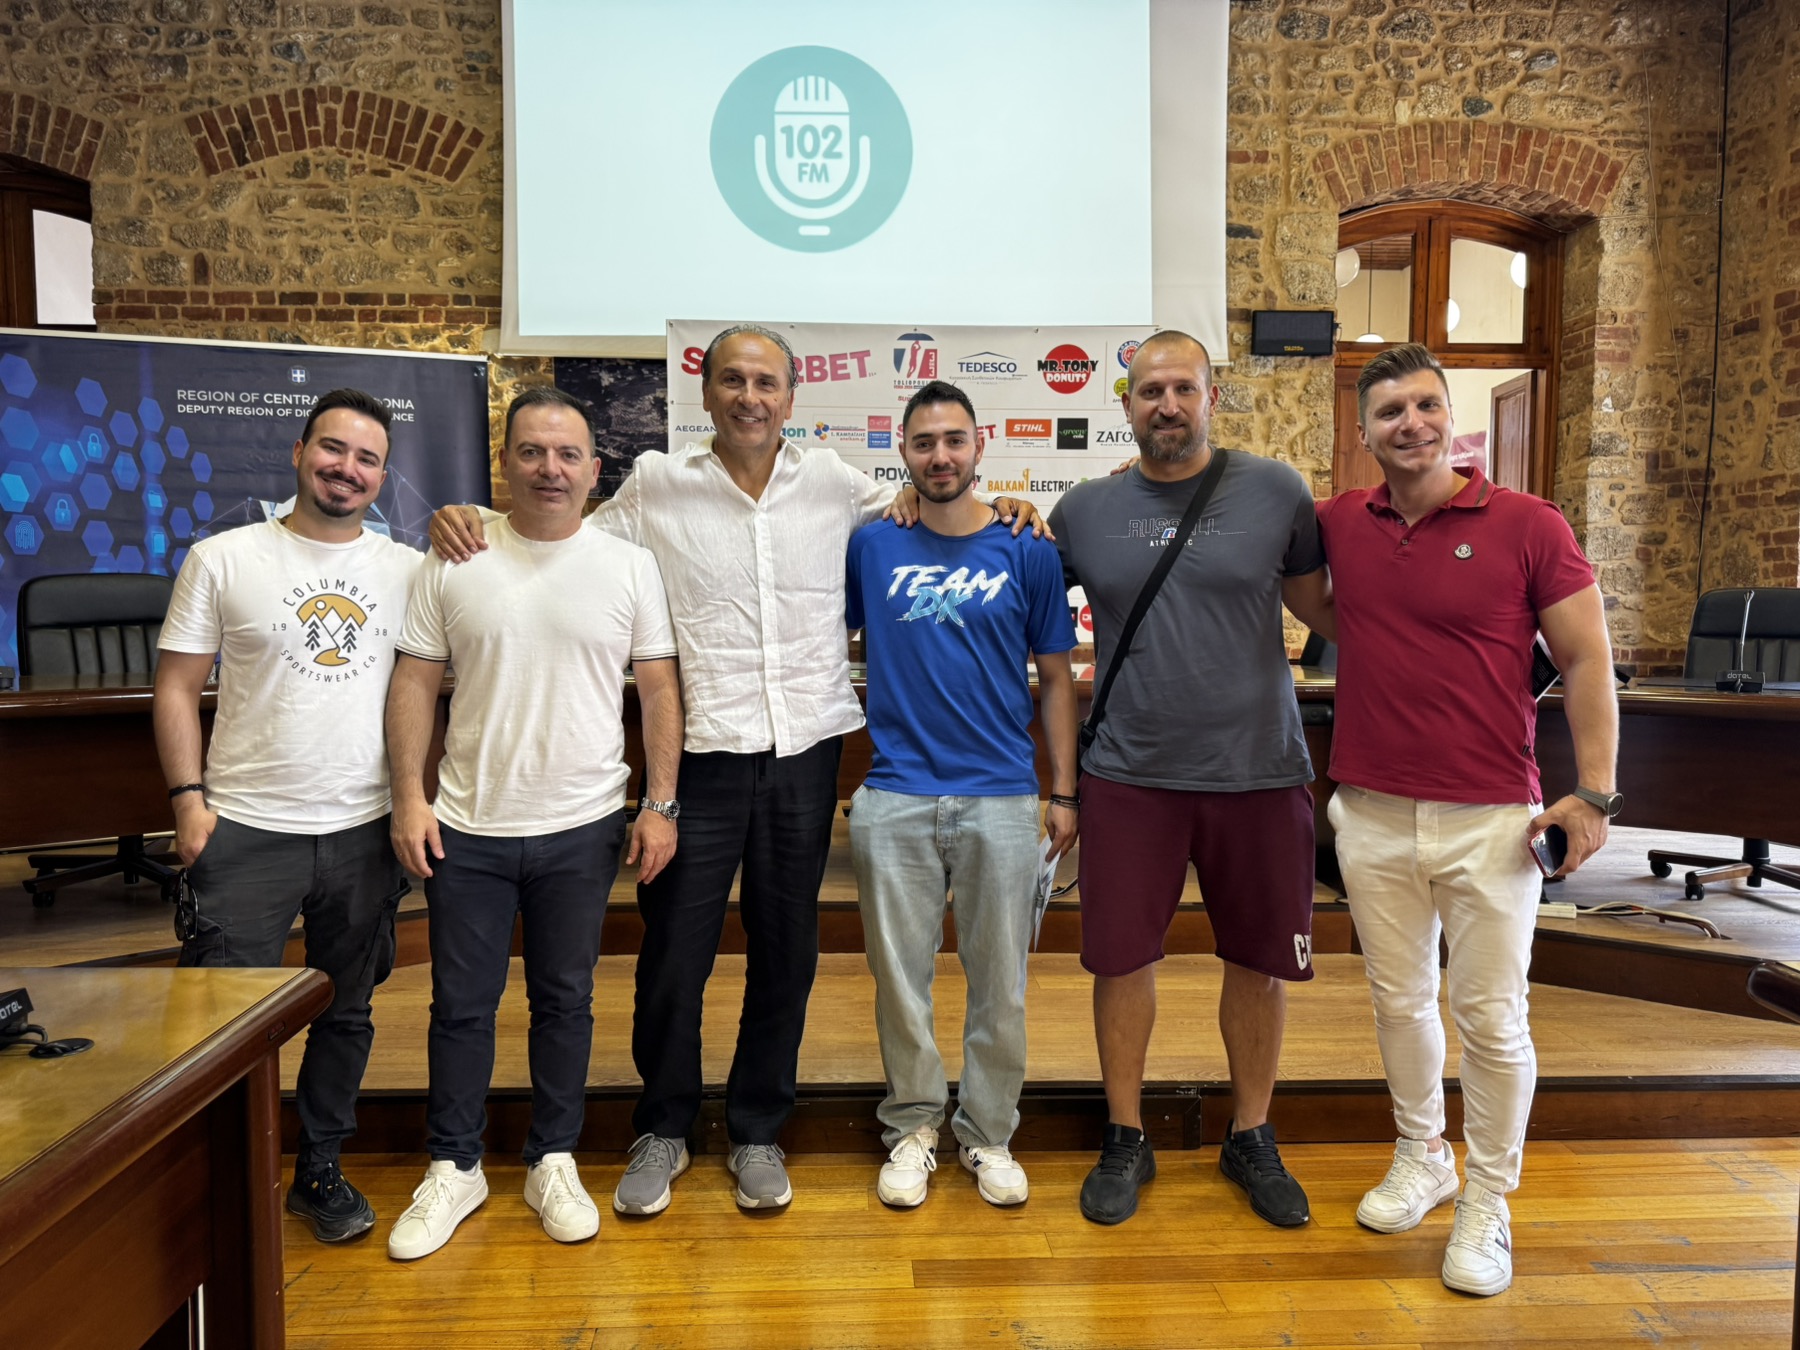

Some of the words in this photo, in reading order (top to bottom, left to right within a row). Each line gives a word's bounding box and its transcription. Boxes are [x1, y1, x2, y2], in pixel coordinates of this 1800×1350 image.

[780, 124, 843, 160] 102
[798, 163, 830, 183] FM
[958, 362, 1017, 373] TEDESCO
[1037, 360, 1099, 372] MR.TONY
[1046, 373, 1087, 383] DONUTS
[177, 390, 235, 402] REGION
[240, 393, 260, 403] OF
[263, 393, 319, 405] CENTRA
[177, 404, 224, 414] DEPUTY
[227, 406, 272, 416] REGION
[277, 408, 293, 417] OF
[1013, 424, 1045, 432] STIHL
[875, 468, 912, 481] POW
[987, 480, 1025, 492] BALKAN
[1030, 480, 1075, 492] ELECTRIC
[1129, 518, 1221, 538] RUSSLL
[887, 565, 1009, 606] TEAM
[283, 579, 377, 612] COLUMBIA
[896, 586, 976, 628] DK
[272, 623, 287, 631] 19
[374, 628, 388, 636] 38
[281, 649, 359, 683] SPORTSWEAR
